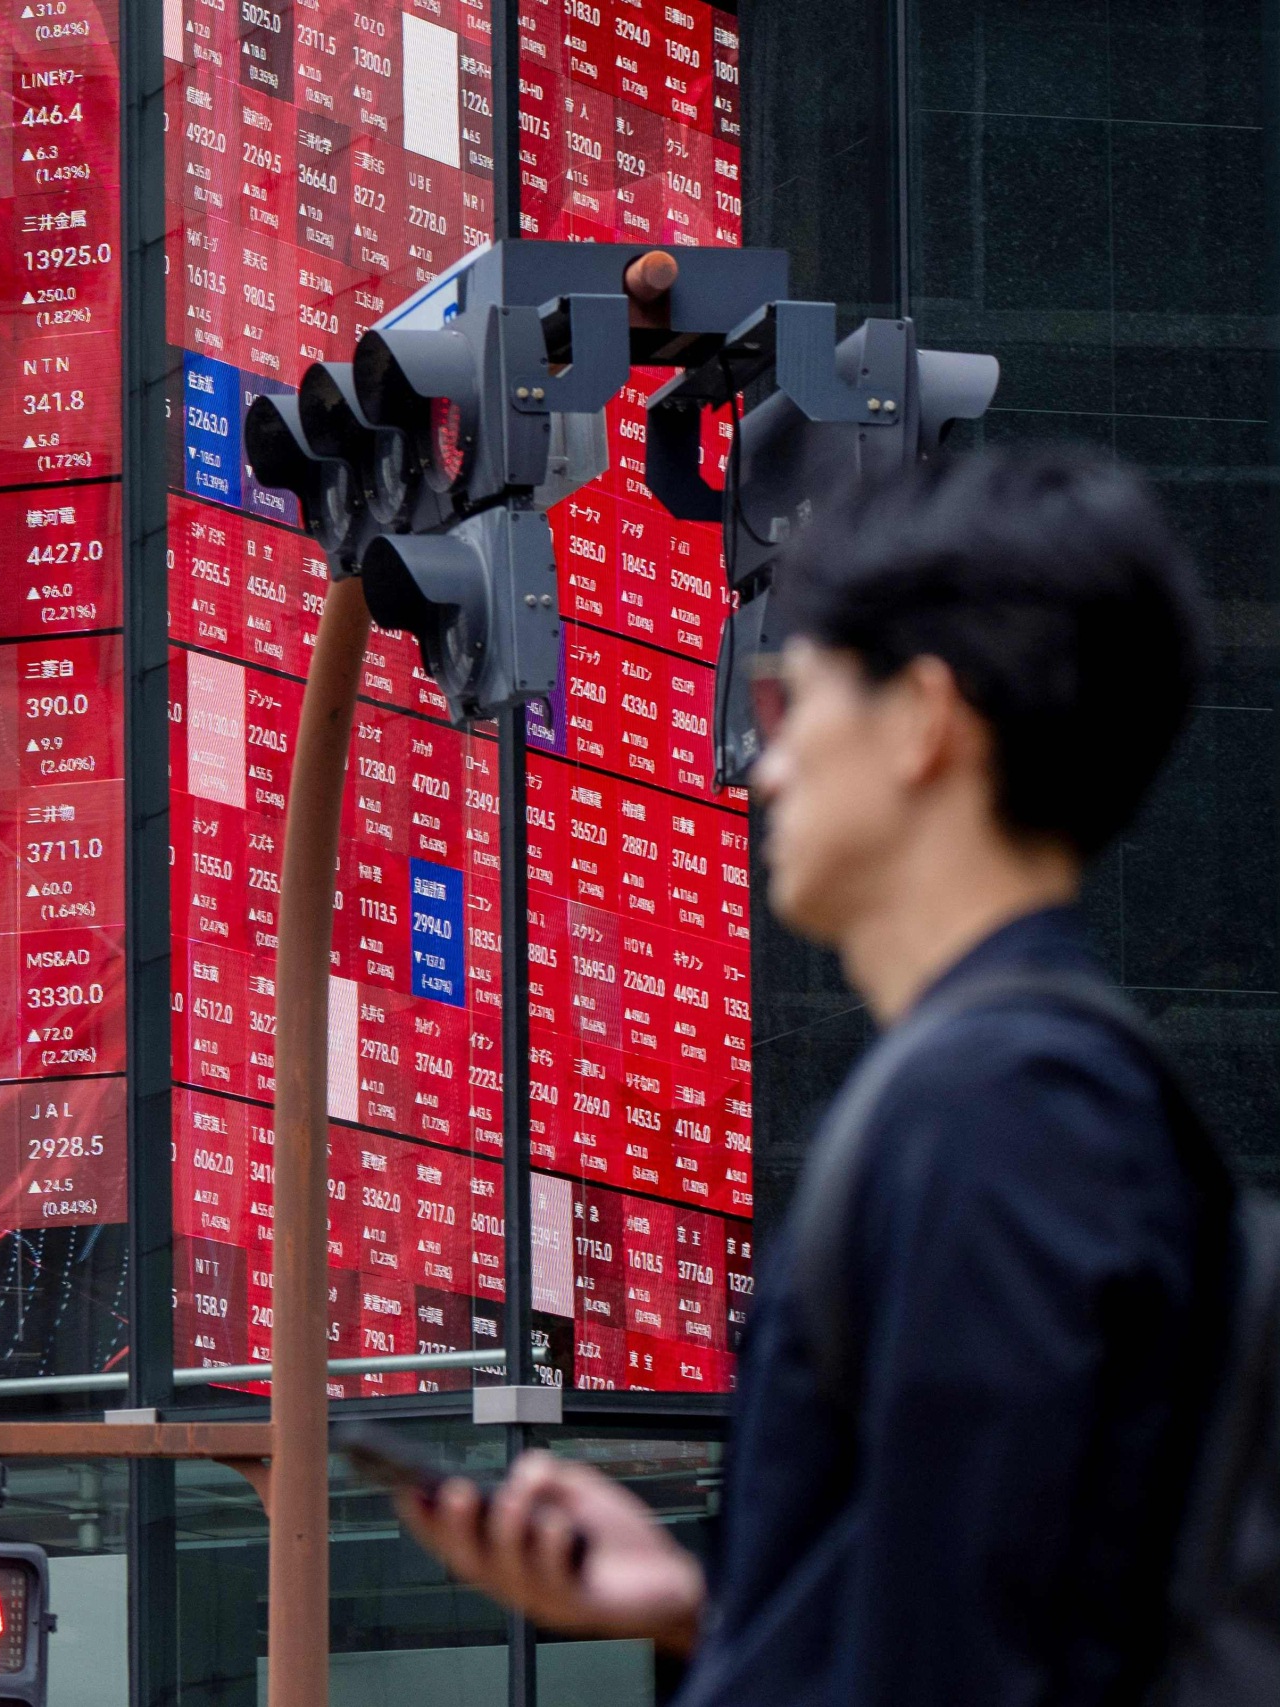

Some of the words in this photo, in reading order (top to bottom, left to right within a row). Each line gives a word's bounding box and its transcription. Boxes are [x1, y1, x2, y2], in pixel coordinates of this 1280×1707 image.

[21, 103, 83, 127] 446.4
[36, 164, 90, 183] (1.43%)
[22, 210, 86, 232] 三井金属
[24, 243, 111, 270] 13925.0
[37, 307, 91, 327] (1.82%)
[24, 390, 84, 414] 341.8
[38, 451, 91, 471] (1.72%)
[27, 541, 103, 565] 4427.0
[42, 603, 96, 622] (2.21%)
[26, 660, 73, 678] 三菱自
[27, 694, 88, 718] 390.0
[248, 689, 281, 709] デンソー
[193, 817, 218, 837] ホンダ
[27, 838, 102, 863] 3711.0
[249, 834, 274, 852] スズキ
[42, 902, 95, 920] (1.64%)
[624, 937, 653, 957] HOYA
[27, 949, 89, 968] MS&AD
[28, 984, 103, 1008] 3330.0
[42, 1047, 96, 1066] (2.20%)
[29, 1135, 103, 1159] 2928.5
